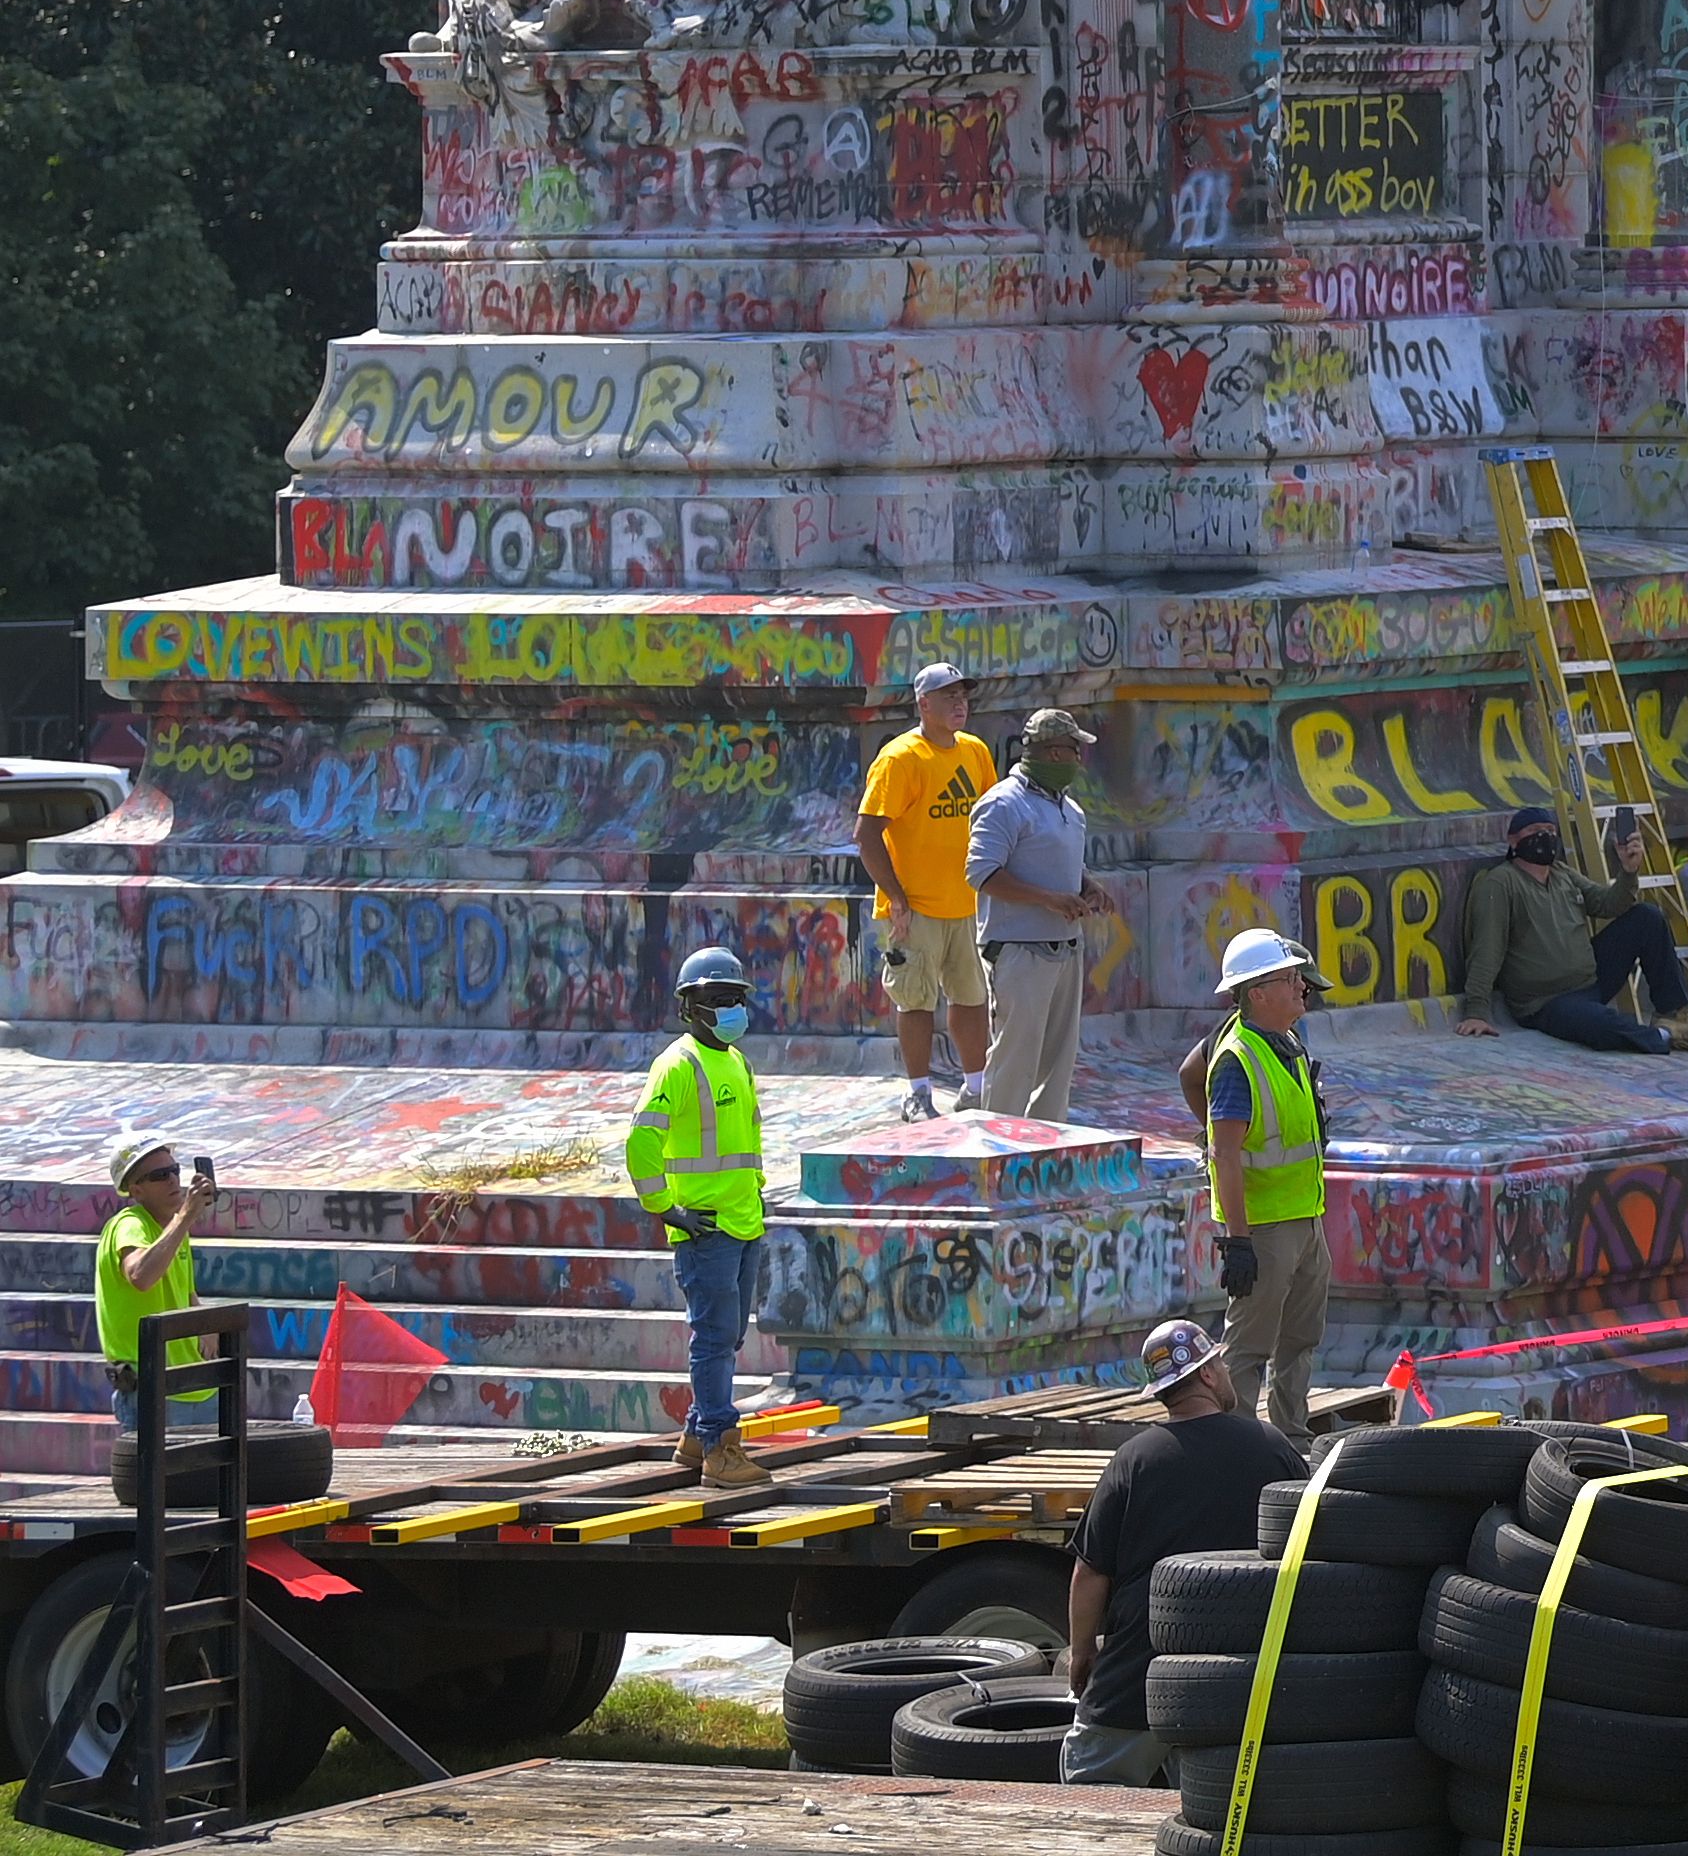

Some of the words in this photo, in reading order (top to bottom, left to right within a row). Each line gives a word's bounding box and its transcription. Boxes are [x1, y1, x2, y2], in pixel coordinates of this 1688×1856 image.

[971, 49, 1032, 74] BLM
[1368, 320, 1452, 382] than
[310, 355, 703, 461] AMOUR
[394, 502, 736, 590] NOIRE
[153, 724, 254, 782] Love
[672, 742, 788, 797] Love
[928, 797, 976, 820] adid
[349, 894, 508, 1008] RPD
[521, 1379, 651, 1432] BLM
[1227, 1802, 1242, 1846] HUSKY
[1237, 1779, 1249, 1798] WLL
[1506, 1807, 1520, 1852] HUSKY
[1513, 1783, 1525, 1803] WLL
